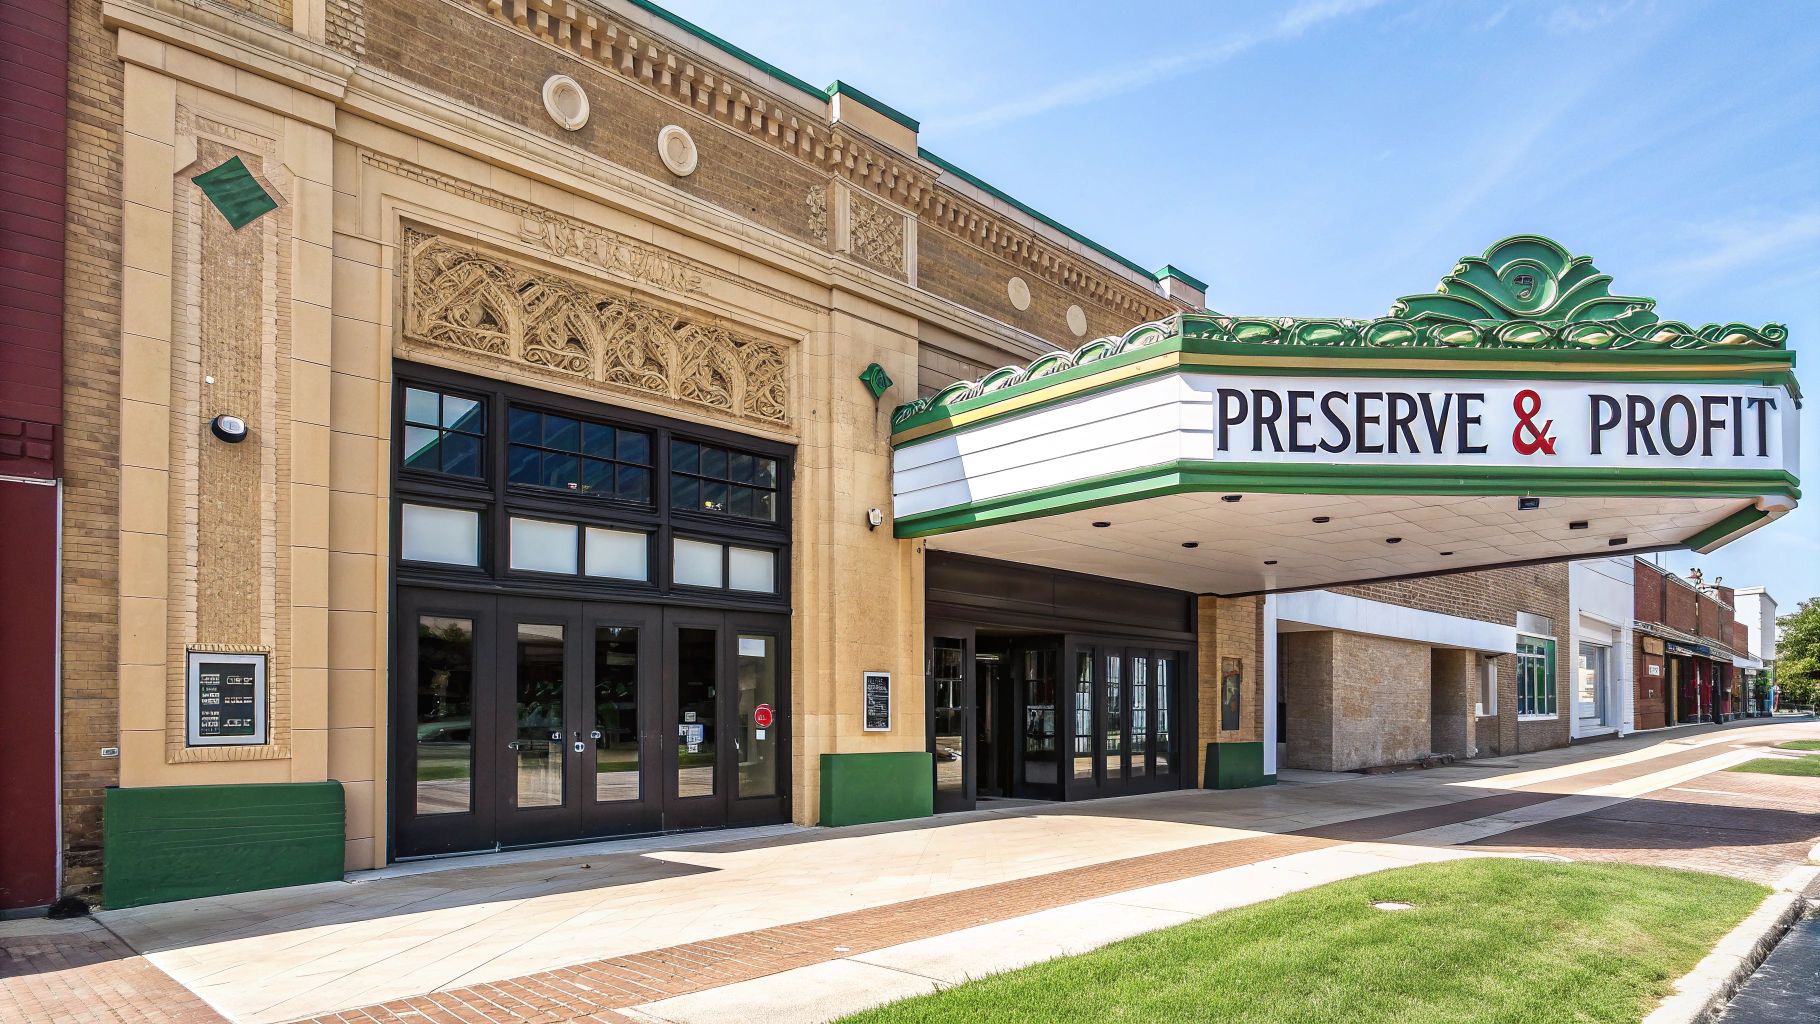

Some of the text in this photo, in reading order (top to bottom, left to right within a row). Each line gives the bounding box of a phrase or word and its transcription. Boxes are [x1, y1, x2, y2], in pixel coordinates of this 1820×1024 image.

[1217, 388, 1778, 457] PRESERVE & PROFIT
